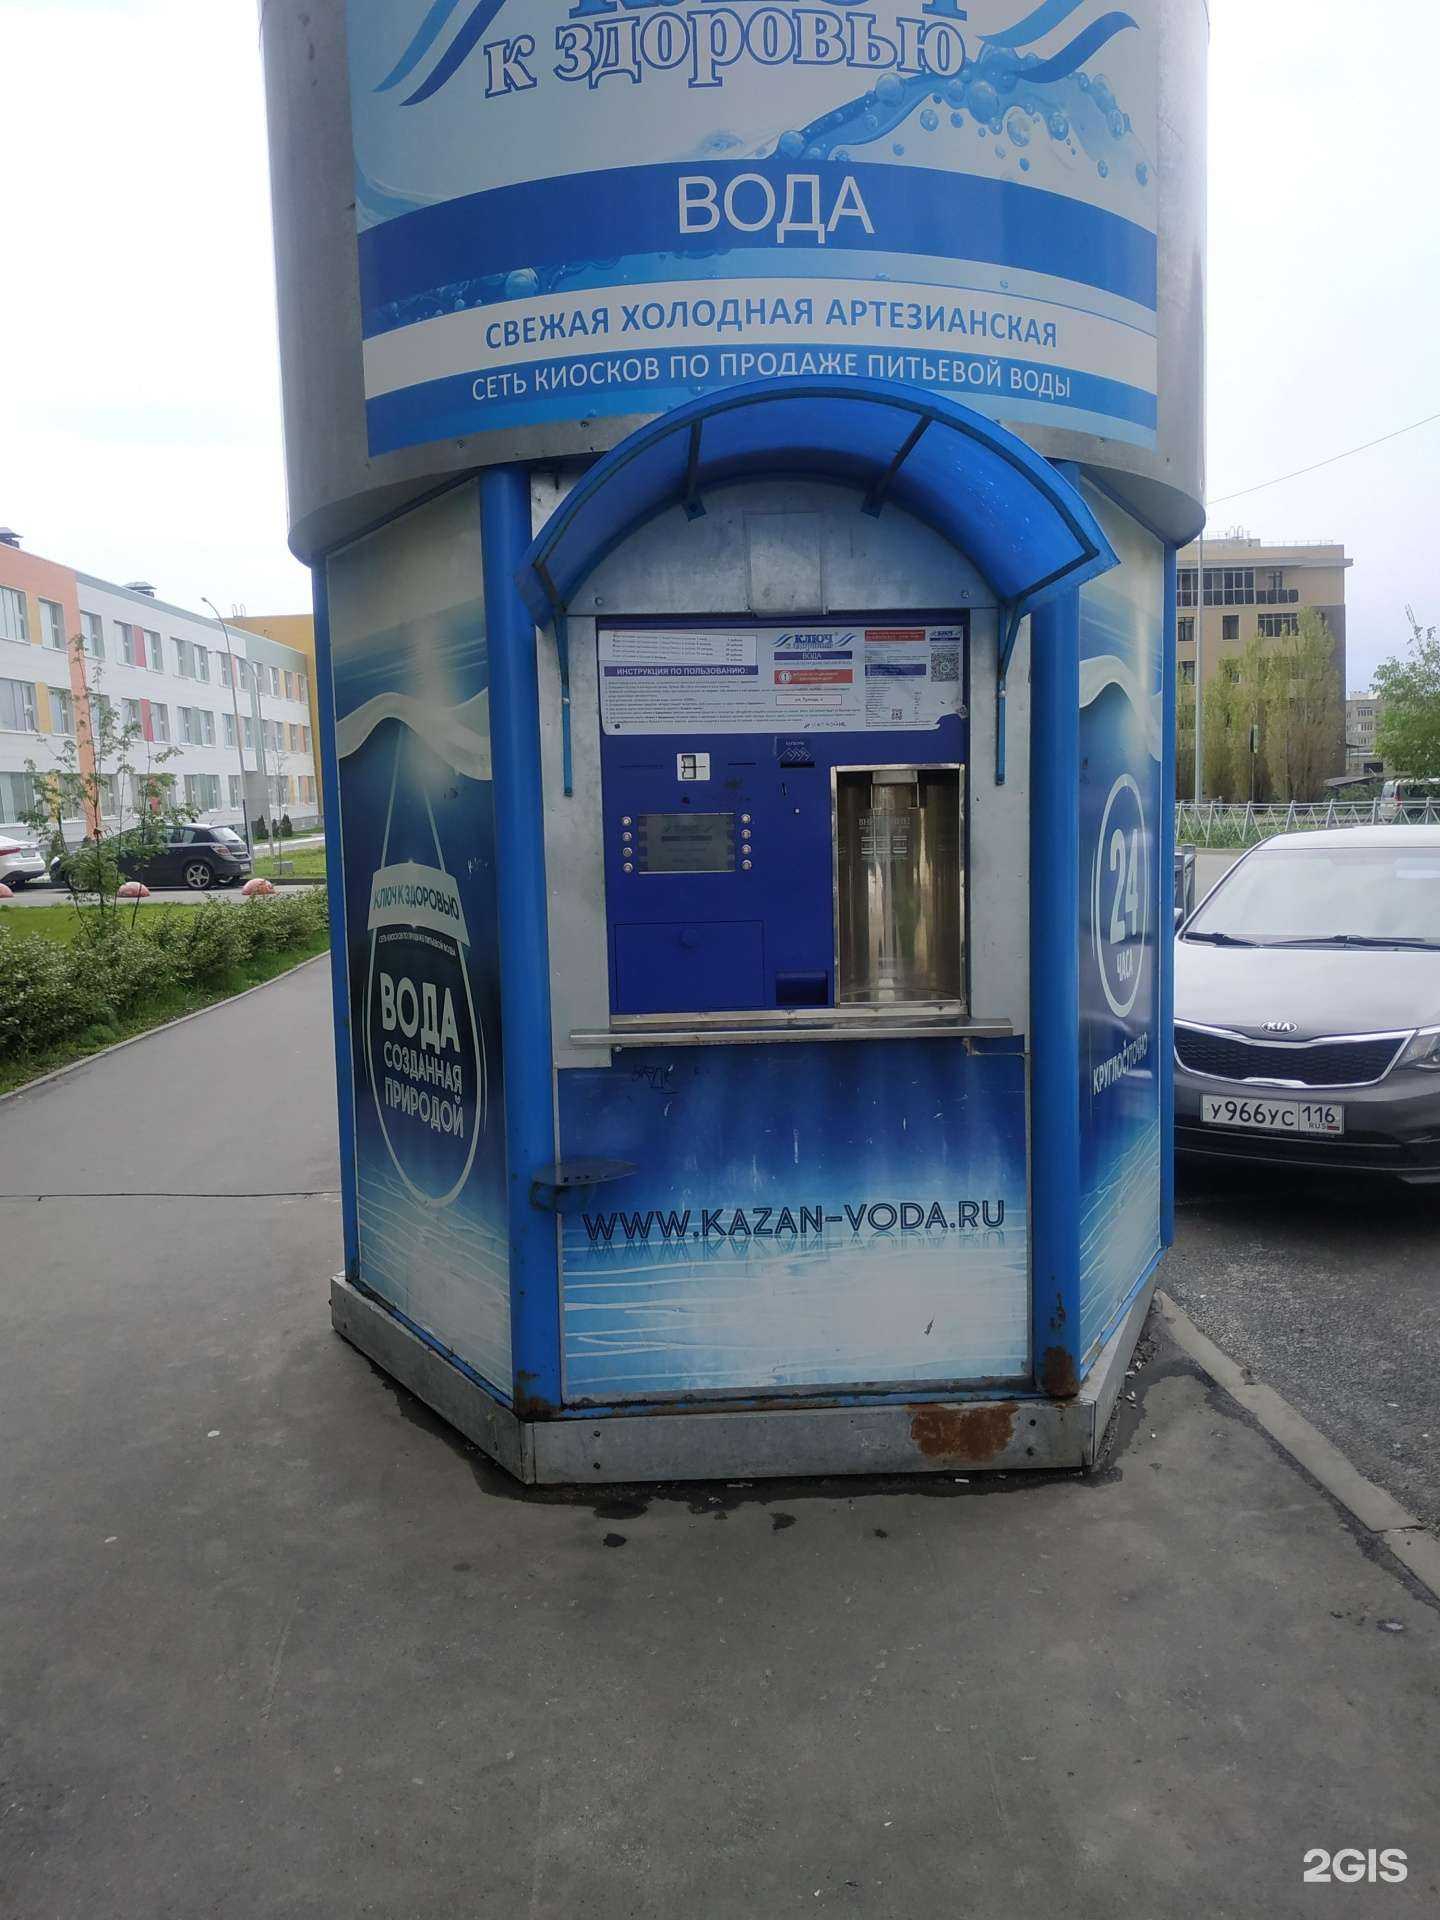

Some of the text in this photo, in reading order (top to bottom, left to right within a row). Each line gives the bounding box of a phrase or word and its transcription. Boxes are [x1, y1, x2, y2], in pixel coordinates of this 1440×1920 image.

[677, 174, 875, 244] ВОДА
[485, 300, 1057, 348] СВЕЖАЯ ХОЛОДНАЯ АРТЕЗИАНСКАЯ
[471, 352, 1071, 402] СЕТЬ КИОСКОВ ПО ПРОДАЖЕ ПИТЬЕВОЙ ВОДЫ
[616, 667, 669, 676] ИНСТРУКЦИЯ
[671, 667, 682, 675] ПО
[1110, 829, 1139, 944] 24
[380, 972, 460, 1053] ВОДА
[1265, 1022, 1292, 1032] KIA
[383, 1041, 462, 1095] СОЗДАННАЯ
[385, 1077, 464, 1139] ПРИРОДОЙ
[1302, 1105, 1336, 1123] 116
[1308, 1122, 1327, 1130] RUS
[583, 1200, 1005, 1241] WWW.KAZAN-VODA.RU
